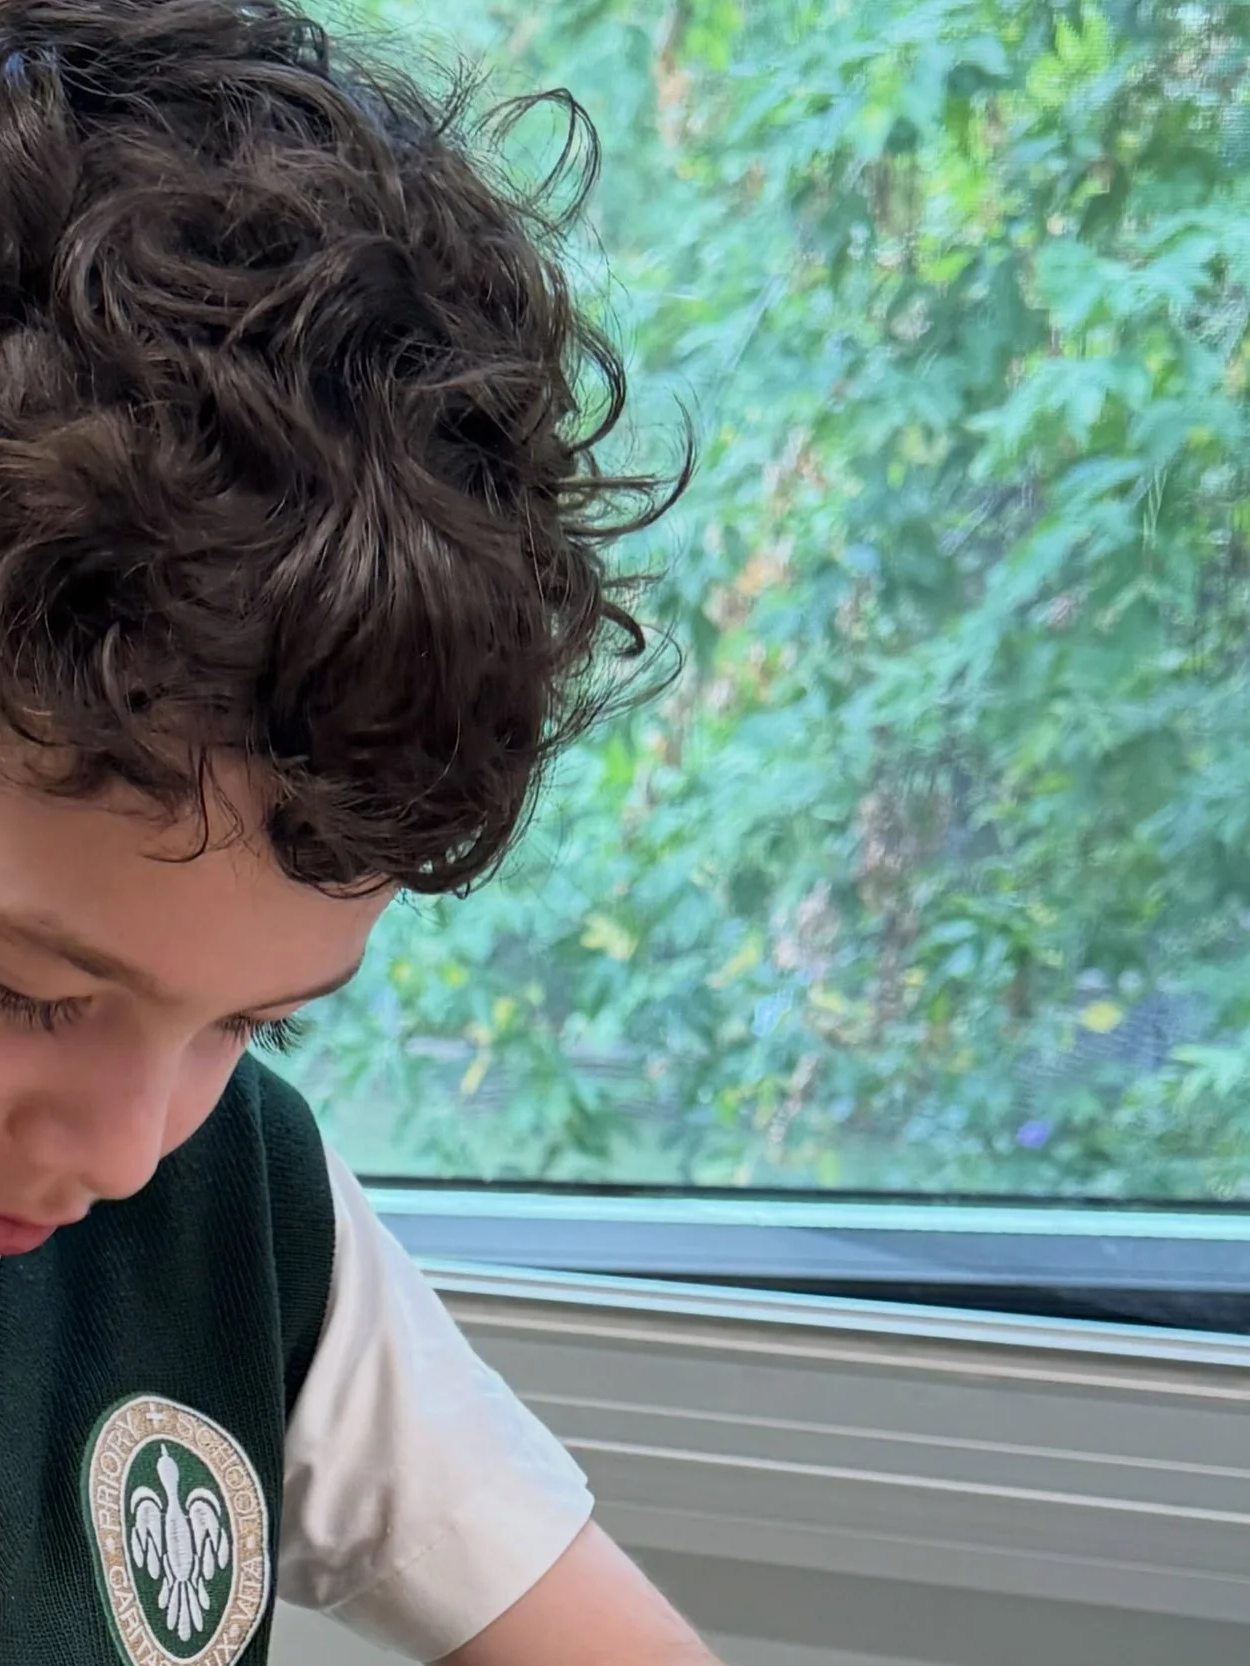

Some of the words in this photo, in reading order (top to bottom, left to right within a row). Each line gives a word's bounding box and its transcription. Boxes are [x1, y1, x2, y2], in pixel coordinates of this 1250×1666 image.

[97, 1411, 141, 1532] PRIORY
[176, 1413, 261, 1534] SCHOOL
[230, 1556, 264, 1621] VITA
